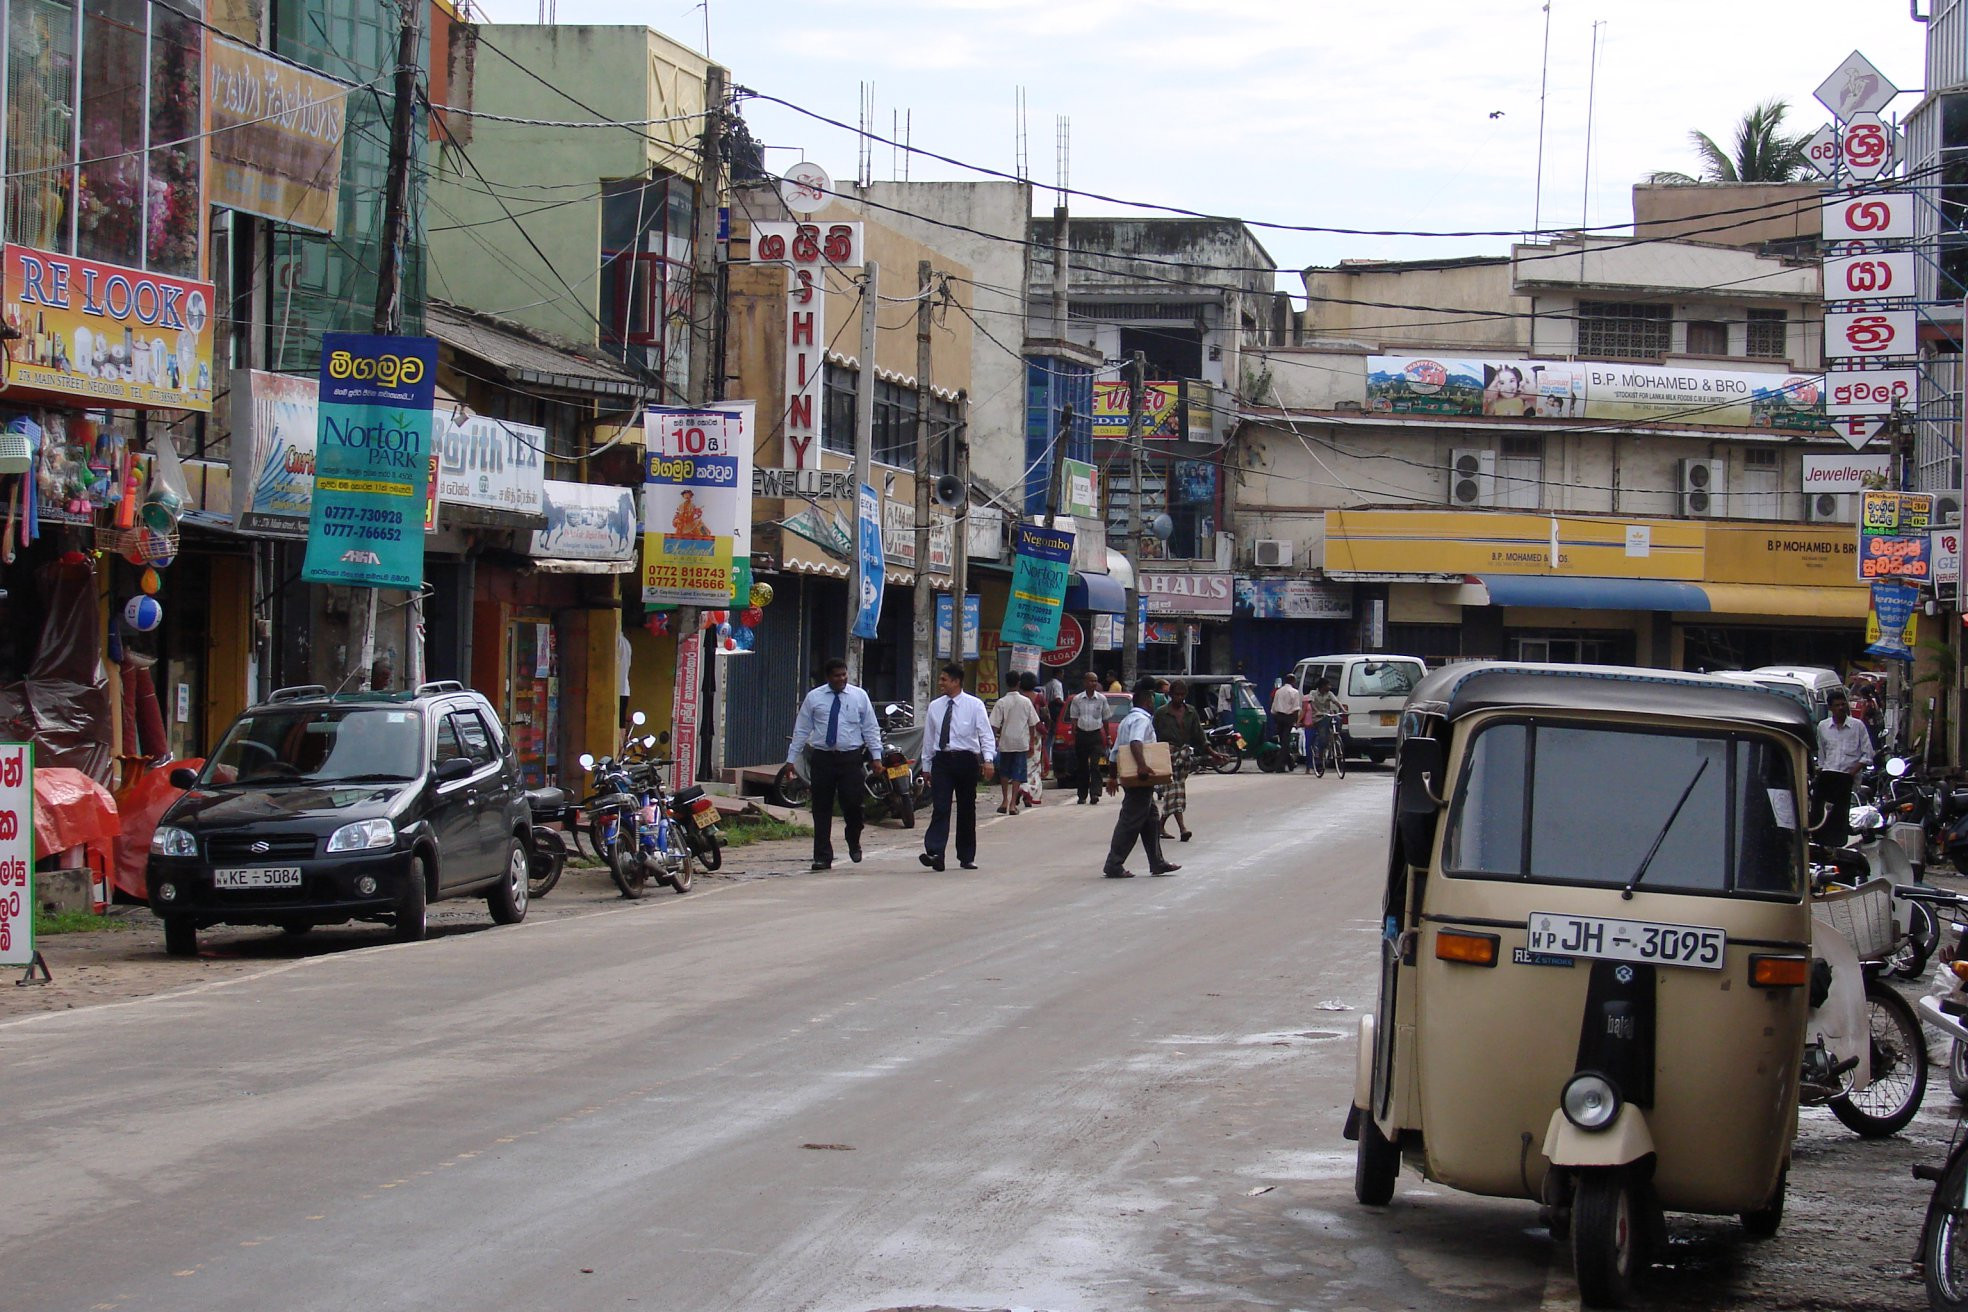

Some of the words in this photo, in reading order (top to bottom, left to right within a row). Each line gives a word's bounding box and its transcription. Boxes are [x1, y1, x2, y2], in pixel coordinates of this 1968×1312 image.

[19, 255, 71, 310] RE
[82, 268, 185, 331] LOOK
[34, 372, 56, 386] MAIN
[328, 350, 425, 388] මීගමුව
[789, 269, 815, 471] SHINY
[1592, 372, 1618, 386] B.P.
[1622, 373, 1698, 391] MOHAMED
[1702, 379, 1712, 391] &
[1716, 379, 1747, 394] BRO
[1107, 390, 1166, 412] VIEO
[322, 415, 420, 453] Norton
[671, 427, 706, 454] 10
[368, 447, 419, 469] PARK
[505, 430, 540, 469] TEX
[650, 456, 695, 482] මීගමුව
[1805, 466, 1872, 482] Jewellers
[751, 469, 857, 499] EWELLERS
[324, 505, 403, 525] 0777-730928
[1913, 502, 1927, 510] 30
[1913, 517, 1926, 526] 02
[323, 523, 402, 542] 0777-766652
[1023, 530, 1070, 551] Negombo
[1784, 541, 1832, 553] MOHAMED
[1834, 544, 1840, 553] &
[1506, 553, 1542, 562] MOHAMED
[1543, 554, 1549, 562] &
[648, 565, 677, 577] 0772
[681, 566, 725, 579] 818743
[1020, 559, 1064, 584] Norton
[648, 576, 677, 588] 0772
[681, 577, 725, 590] 745666
[1875, 594, 1914, 607] lenovo
[1060, 635, 1075, 645] kit
[1041, 650, 1077, 662] RELOAD
[229, 869, 248, 884] KE
[263, 868, 299, 884] 5084
[1561, 920, 1604, 953] JH
[1639, 927, 1721, 964] 3095
